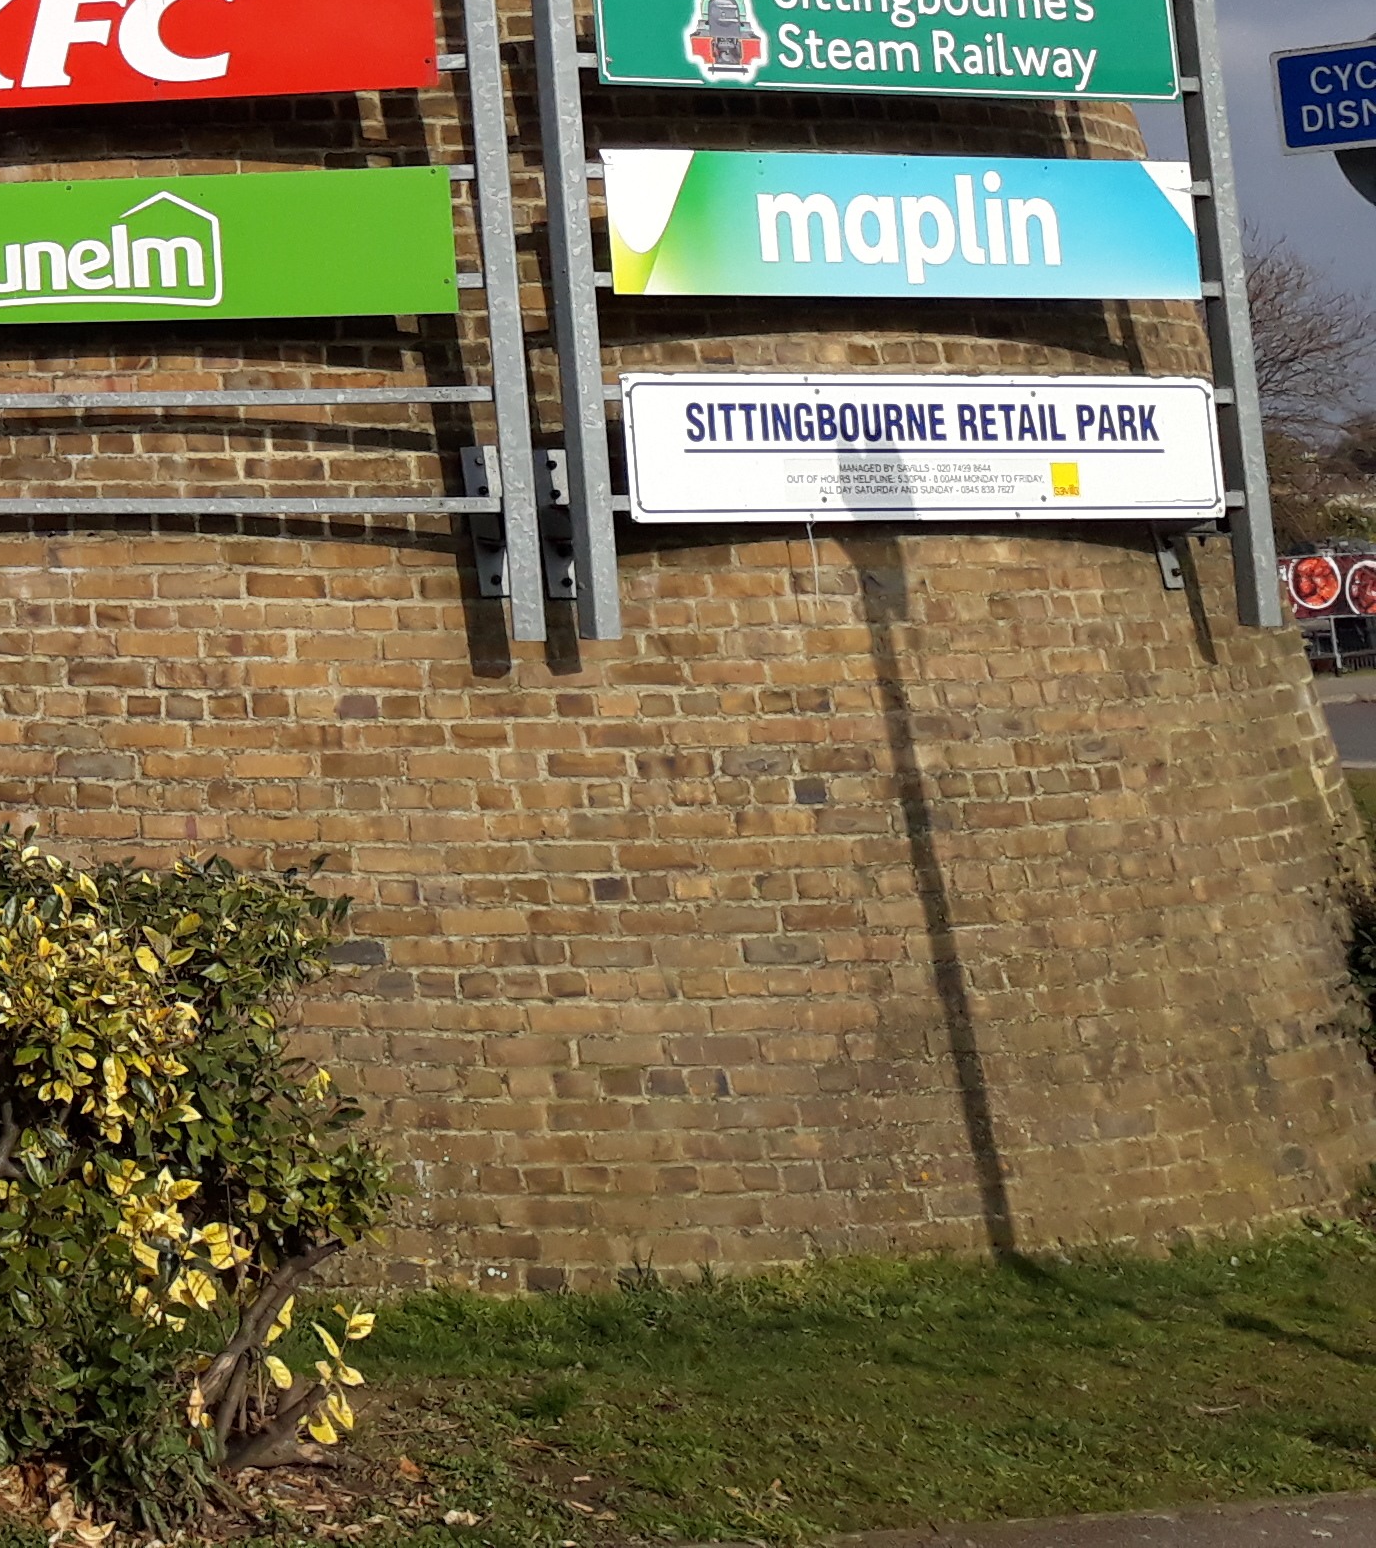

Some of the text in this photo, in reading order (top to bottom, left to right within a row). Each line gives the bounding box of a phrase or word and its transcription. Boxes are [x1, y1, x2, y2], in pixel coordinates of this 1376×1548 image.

[778, 24, 1097, 92] Steam Railway
[756, 170, 1063, 285] maplin
[685, 402, 1160, 443] SITTINGBOURNE RETAIL PARK
[786, 474, 804, 483] OUT
[806, 474, 817, 483] OF
[820, 474, 850, 483] HOURS
[963, 474, 999, 483] MONDAY
[1001, 474, 1012, 483] TO
[839, 463, 881, 472] MANAGED
[883, 463, 894, 472] BY
[819, 485, 834, 494] ALL
[835, 485, 851, 494] DAY
[854, 485, 898, 494] SATURDAY
[900, 485, 918, 494] AND
[920, 485, 953, 494] SUNDAY
